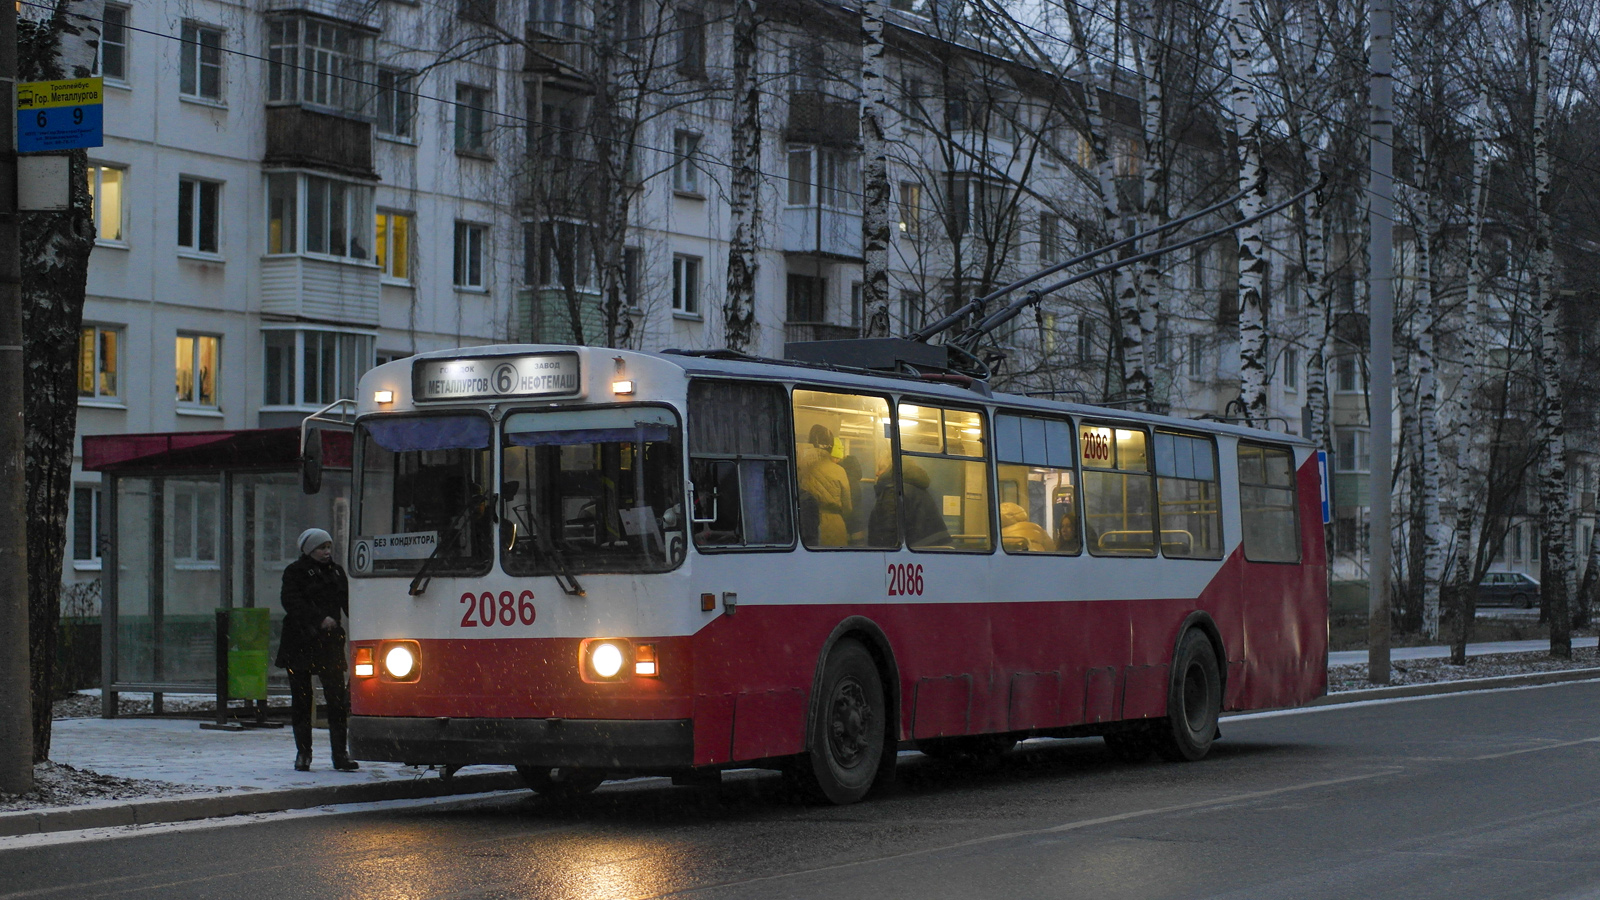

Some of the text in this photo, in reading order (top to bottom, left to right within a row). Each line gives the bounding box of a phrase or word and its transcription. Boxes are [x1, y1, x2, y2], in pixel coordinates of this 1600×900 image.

[34, 91, 98, 105] Гор. Металлургов
[50, 82, 89, 92] Троллейбус
[36, 107, 83, 128] 6 9
[534, 362, 560, 370] ЗАВОД
[428, 366, 575, 394] МЕТАЛЛУРГОВ 6 НЕФТЕМАШ
[1083, 432, 1109, 460] 2086
[374, 535, 435, 548] БЕЗ КОНДУКТОРА
[670, 536, 682, 565] 6
[356, 544, 366, 570] 6
[888, 563, 923, 596] 2086
[460, 590, 536, 627] 2086
